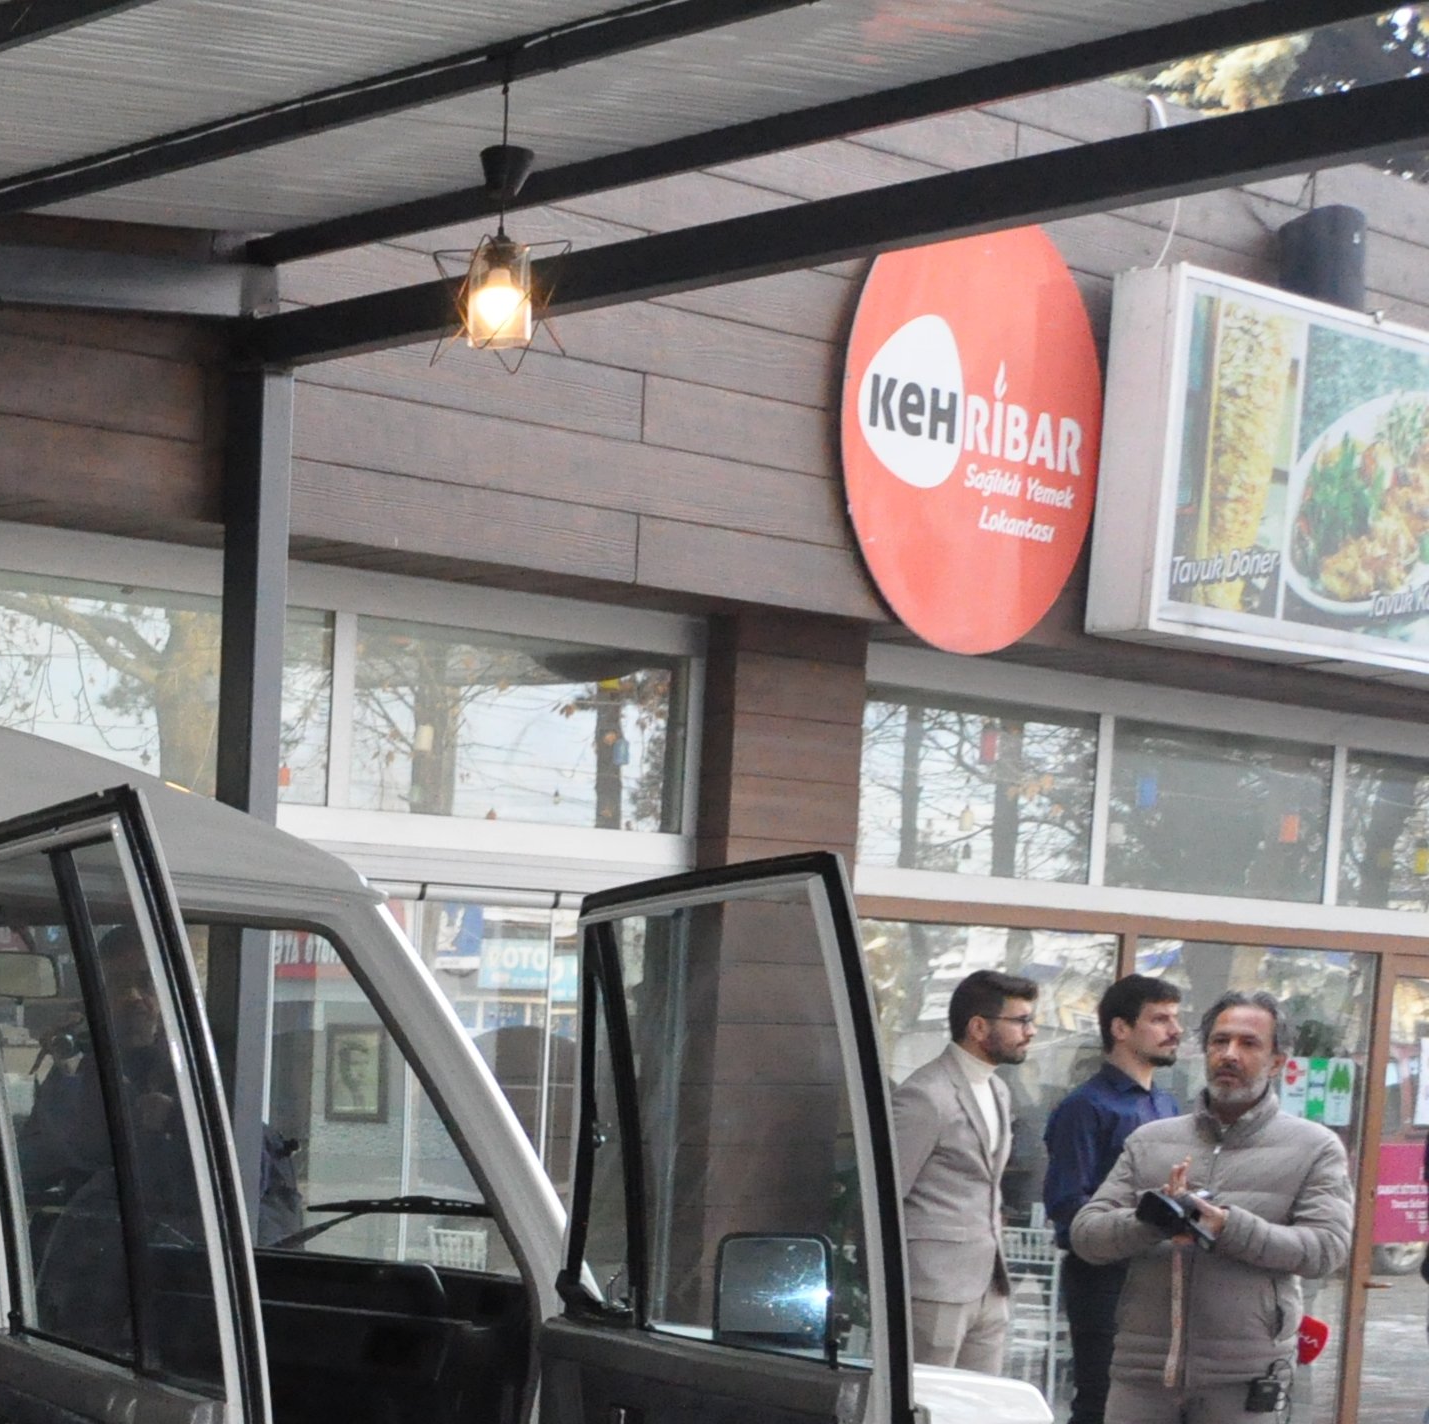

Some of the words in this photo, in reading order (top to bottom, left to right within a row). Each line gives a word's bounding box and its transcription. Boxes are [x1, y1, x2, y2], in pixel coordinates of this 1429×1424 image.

[963, 463, 1022, 497] Sağlıklı
[1025, 476, 1075, 509] Yemek
[977, 505, 1056, 543] Lokantası
[1171, 551, 1223, 585] Tavuk
[1226, 548, 1279, 581] Döner
[1368, 586, 1414, 618] Tavuk
